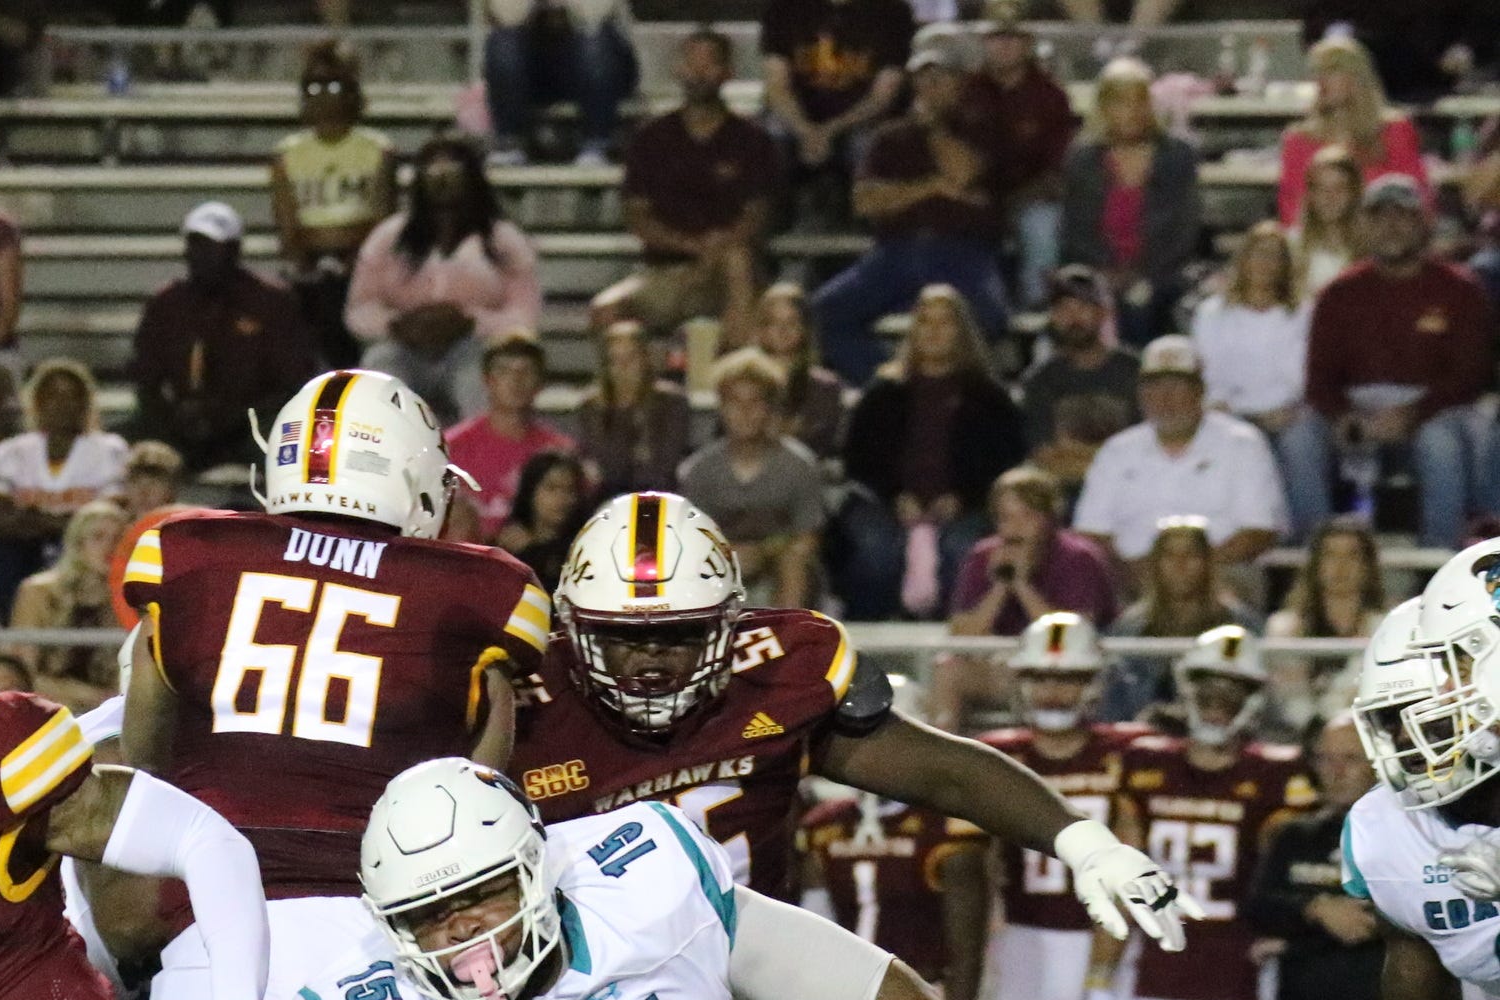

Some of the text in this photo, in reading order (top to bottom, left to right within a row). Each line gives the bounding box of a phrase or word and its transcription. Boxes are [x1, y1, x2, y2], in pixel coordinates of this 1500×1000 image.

[325, 494, 377, 515] YEAH
[283, 527, 388, 579] DUNN
[211, 571, 402, 748] 66
[742, 722, 785, 739] adidas
[523, 759, 590, 800] SBC
[594, 755, 756, 814] WARHAWKS
[586, 821, 658, 880] 15
[852, 860, 879, 945] 1
